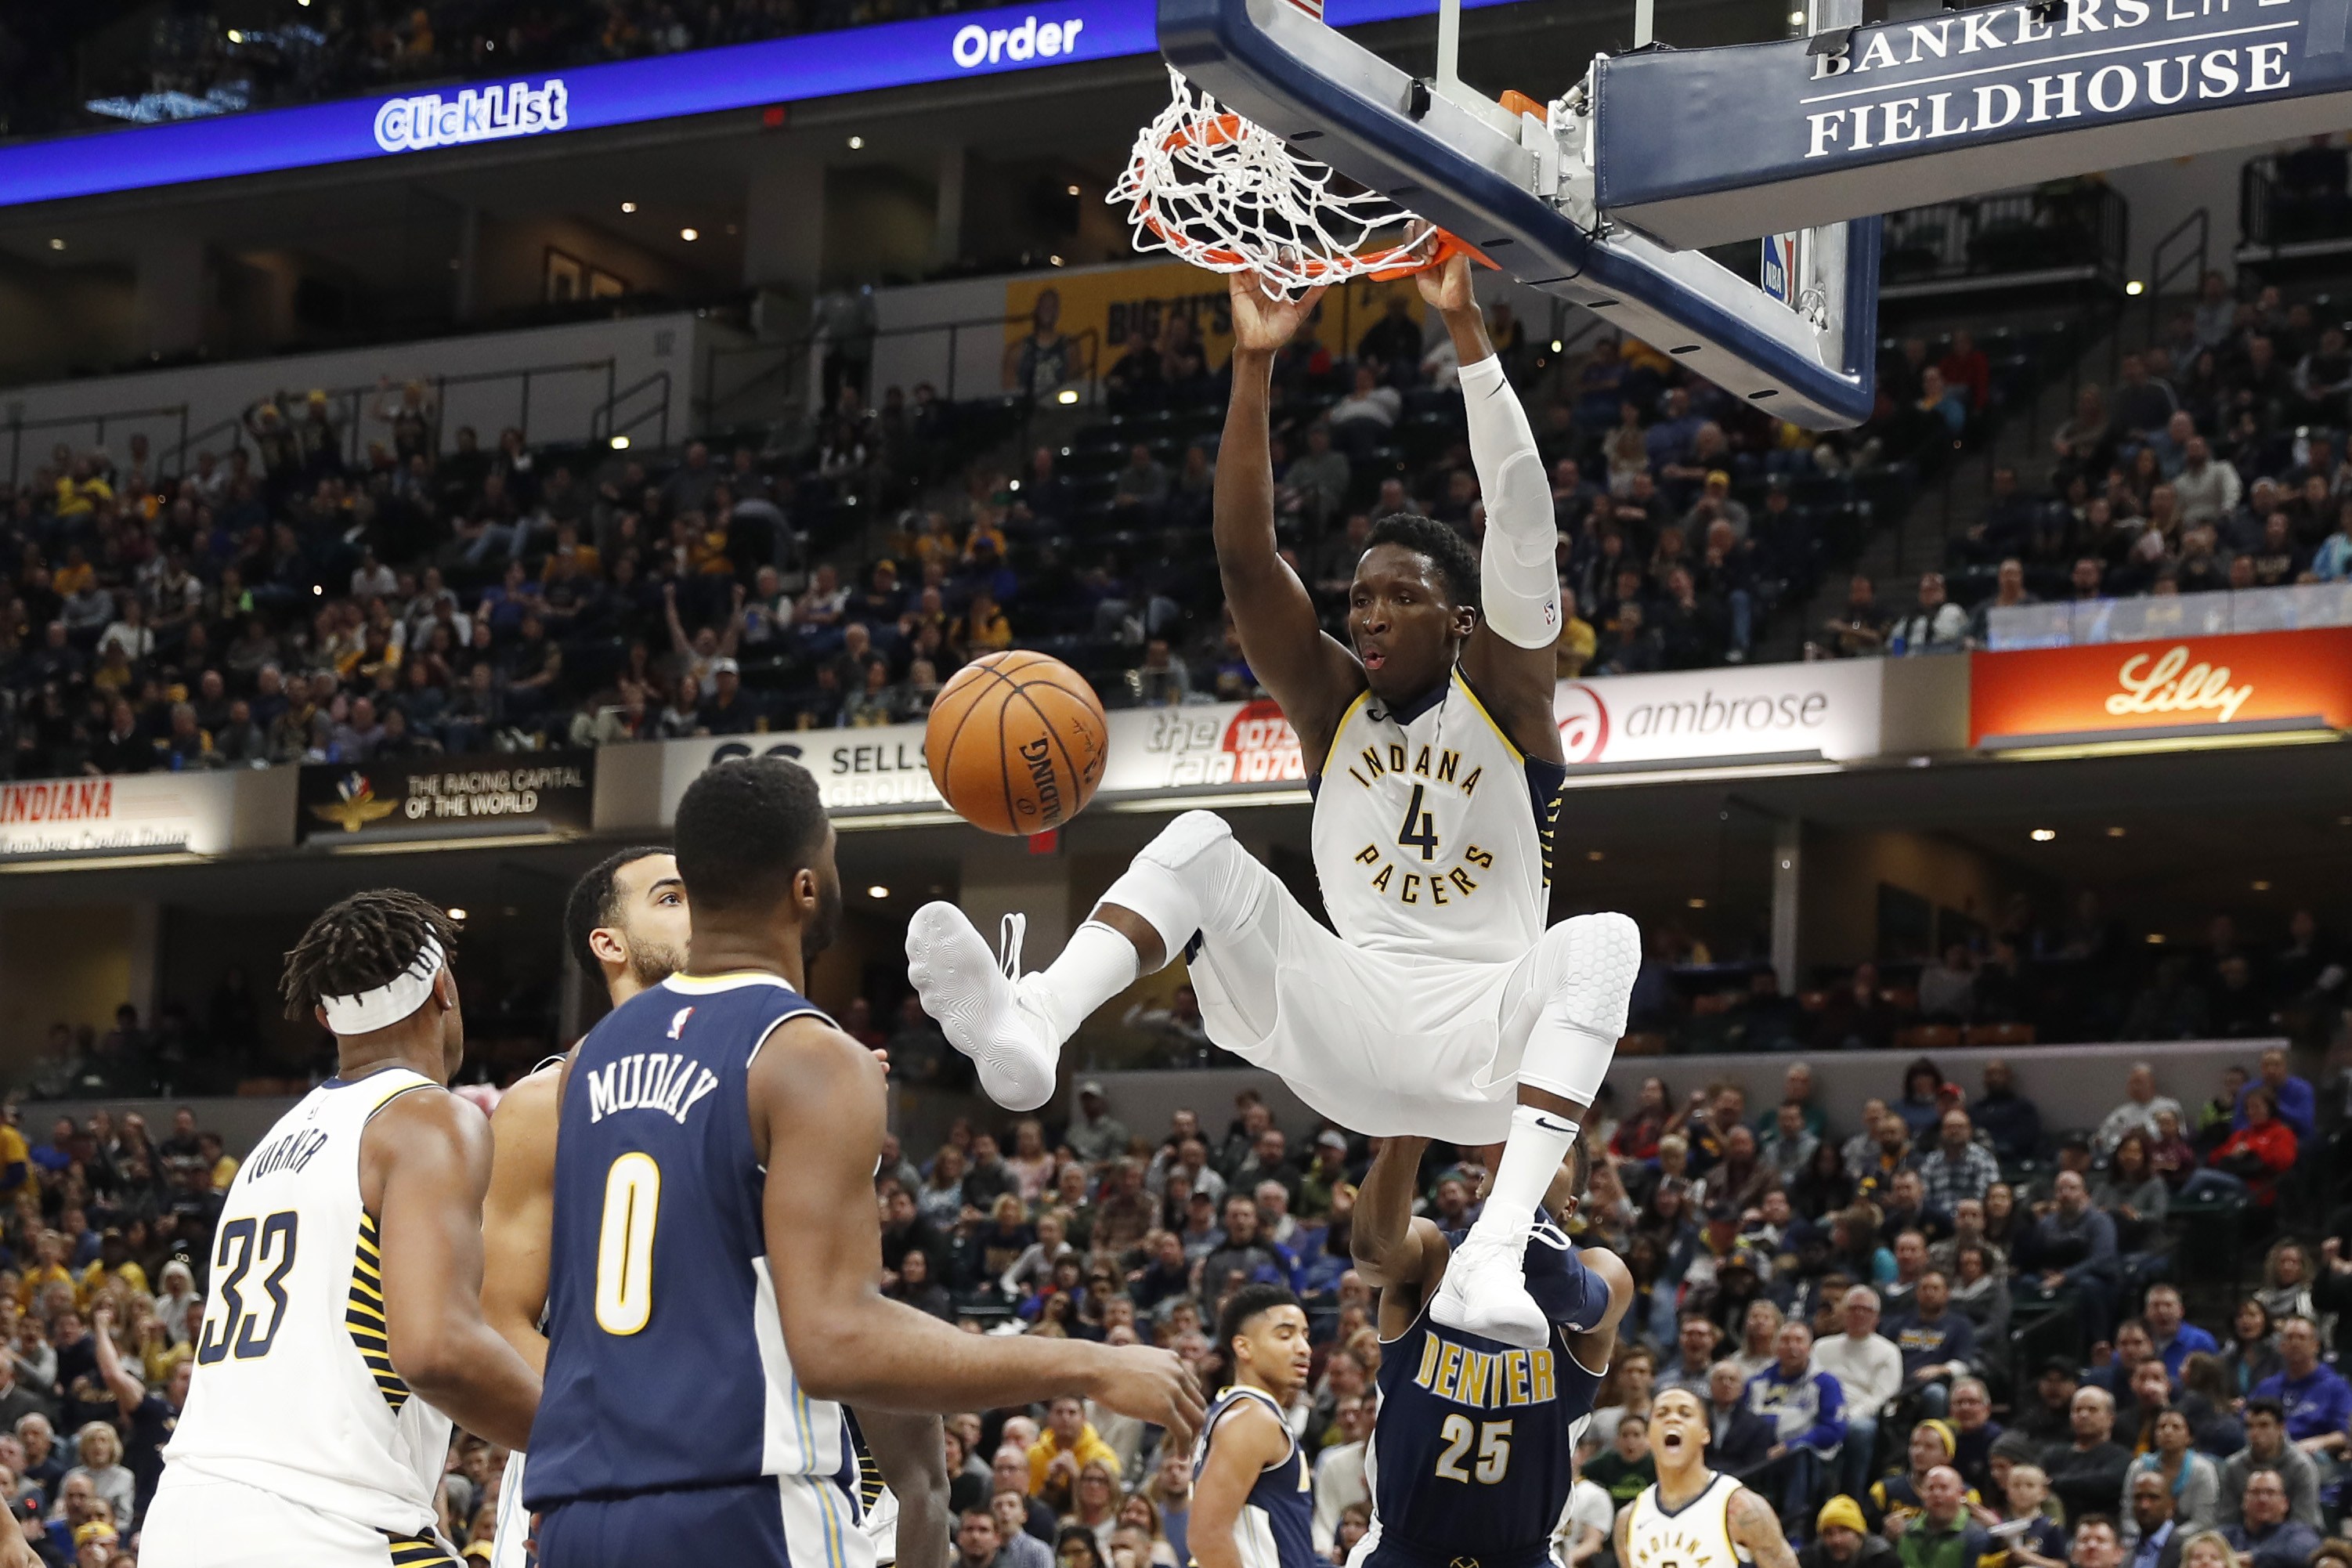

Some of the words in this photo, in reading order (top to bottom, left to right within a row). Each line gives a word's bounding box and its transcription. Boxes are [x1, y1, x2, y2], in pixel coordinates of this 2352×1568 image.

[952, 16, 1083, 67] Order
[374, 78, 568, 152] ClickList
[1805, 42, 2291, 157] FIELDHOUSE
[1765, 261, 1782, 294] NBA
[1625, 688, 1828, 737] ambrose
[2105, 645, 2254, 723] Lilly
[406, 775, 443, 797] THE
[443, 770, 511, 794] RACING
[511, 766, 584, 790] CAPITAL
[1239, 747, 1304, 782] 1070
[0, 782, 114, 824] INDIANA
[405, 797, 432, 819] OF
[435, 793, 468, 818] THE
[469, 789, 538, 815] WORLD
[1398, 782, 1439, 863] 4
[1354, 844, 1494, 905] PACERS
[587, 1052, 719, 1125] MUDIAY
[247, 1128, 328, 1185] TURNER
[594, 1151, 661, 1336] 0
[197, 1210, 299, 1366] 33
[1436, 1413, 1513, 1485] 25
[1637, 1531, 1713, 1568] NDIANA
